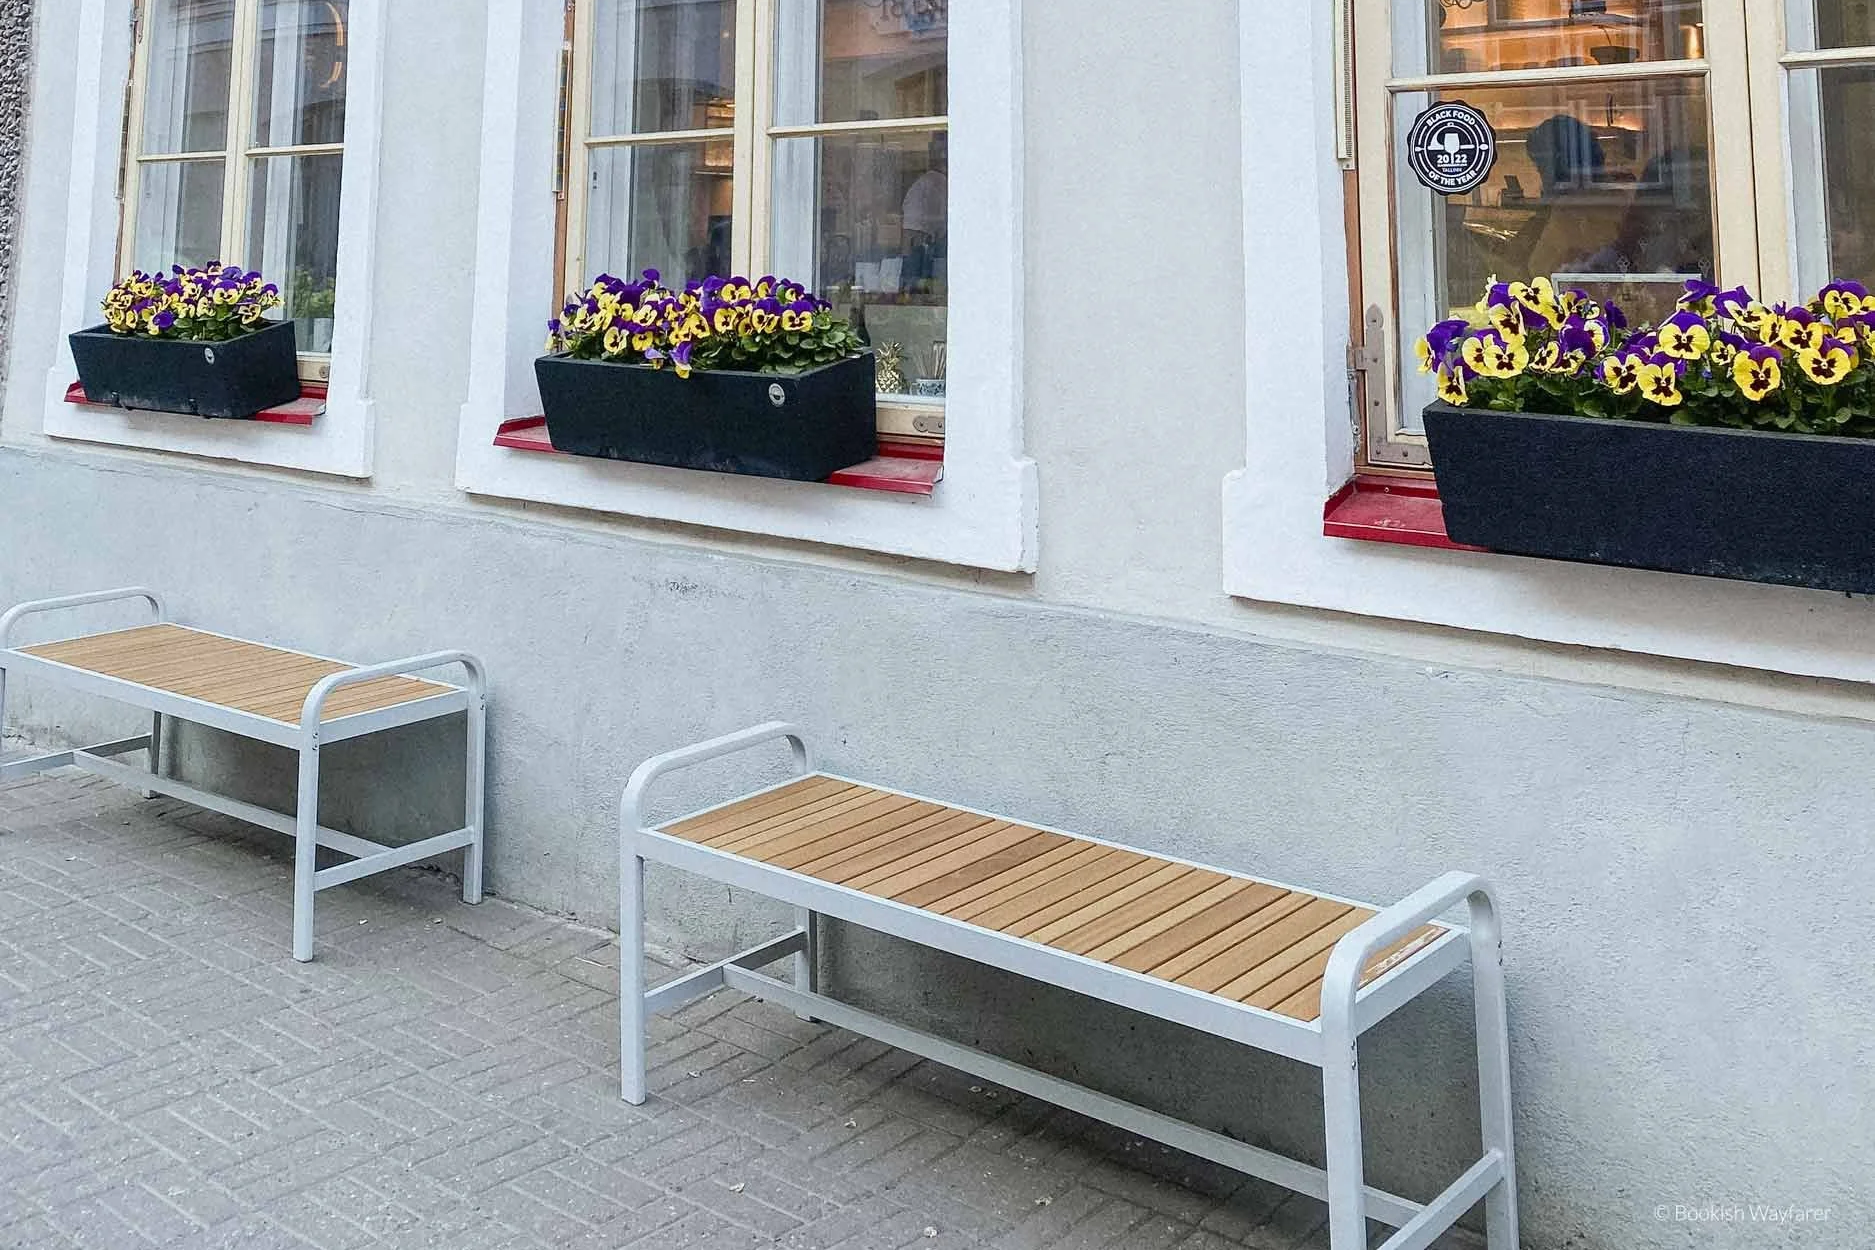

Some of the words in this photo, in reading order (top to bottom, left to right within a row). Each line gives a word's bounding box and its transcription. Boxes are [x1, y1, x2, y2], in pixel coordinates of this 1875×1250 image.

[1426, 110, 1452, 127] BLACK
[1452, 110, 1476, 126] FOOD
[1428, 170, 1440, 181] OF
[1440, 176, 1456, 186] THE
[1456, 169, 1478, 185] YEAR
